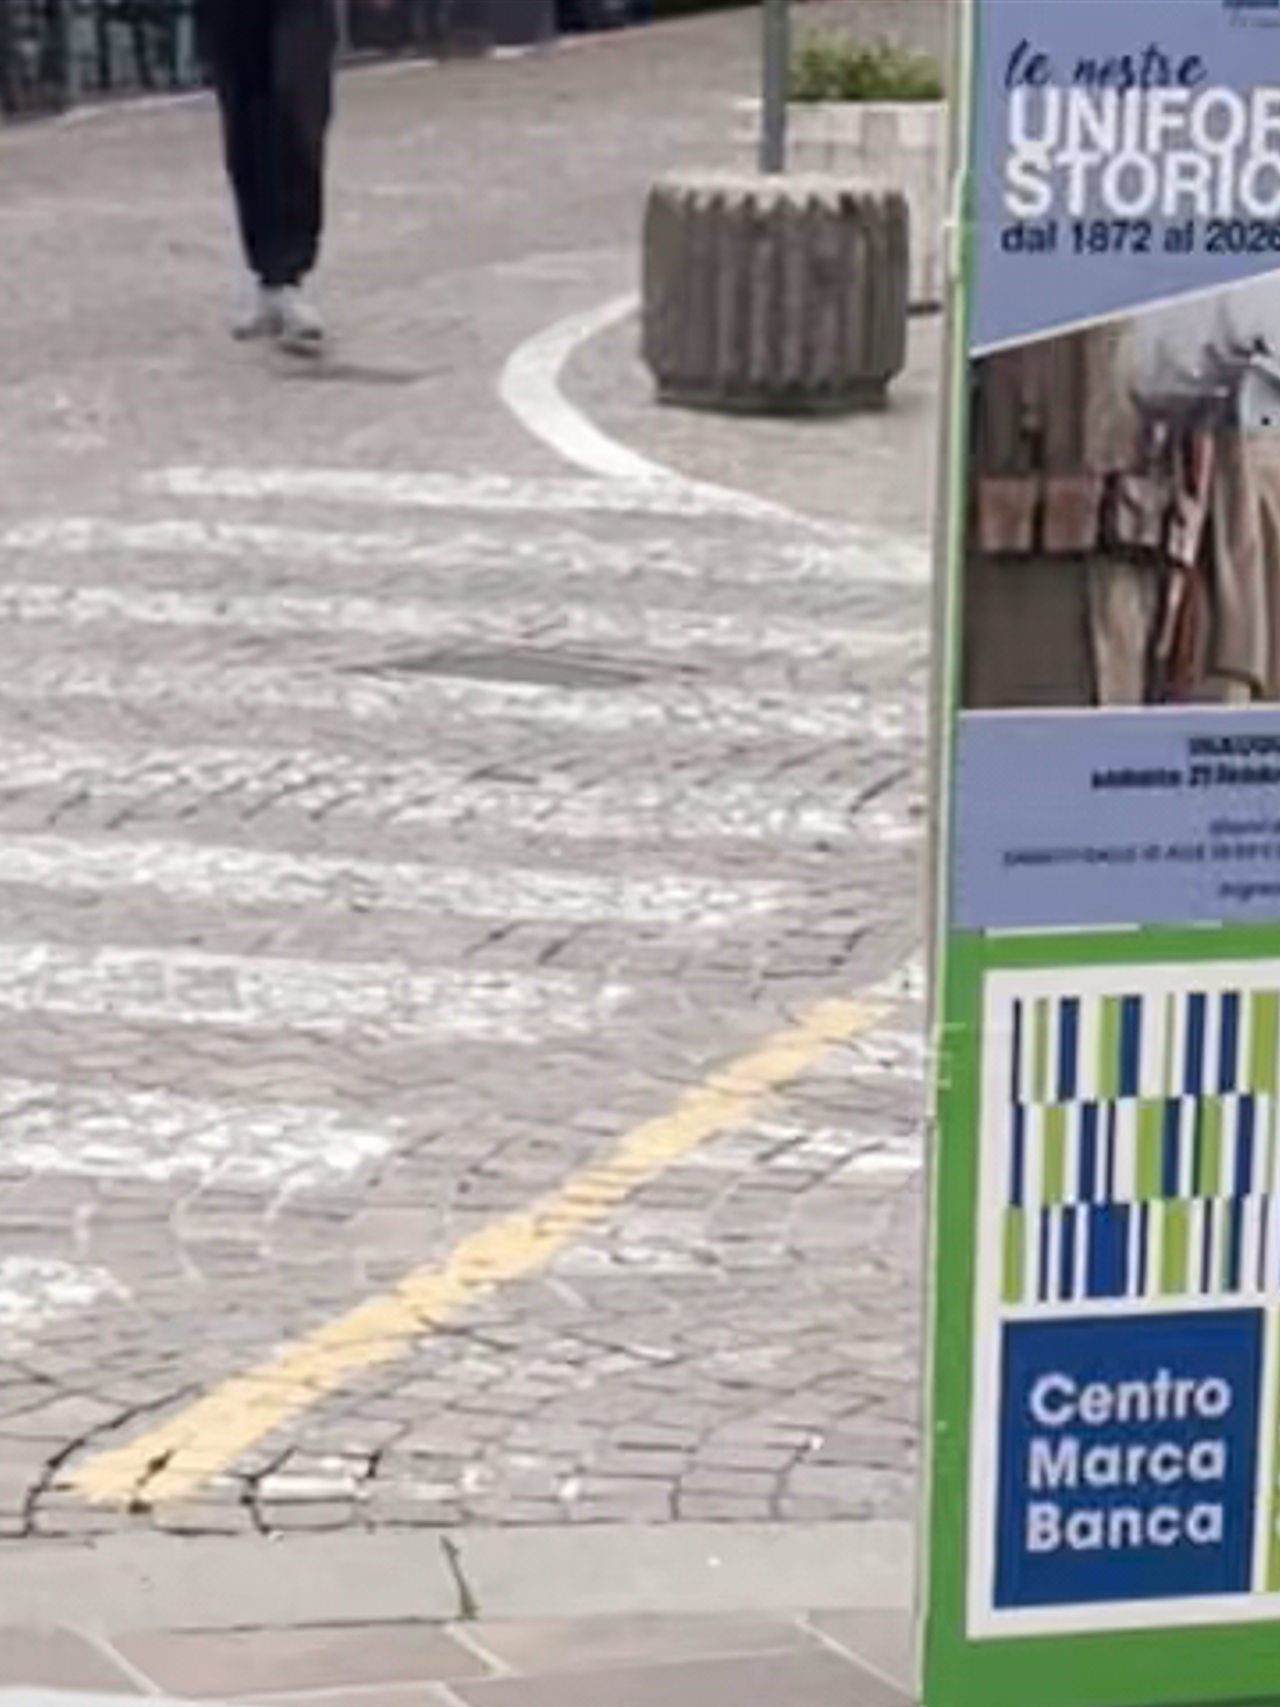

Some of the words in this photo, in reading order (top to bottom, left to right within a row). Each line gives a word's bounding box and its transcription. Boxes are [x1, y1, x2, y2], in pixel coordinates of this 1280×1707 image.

[1001, 220, 1056, 252] dal
[1070, 219, 1151, 252] 1872
[1163, 219, 1194, 251] al
[1028, 1367, 1232, 1426] Centro
[1025, 1436, 1227, 1490] Marca
[1023, 1500, 1225, 1553] Banca
